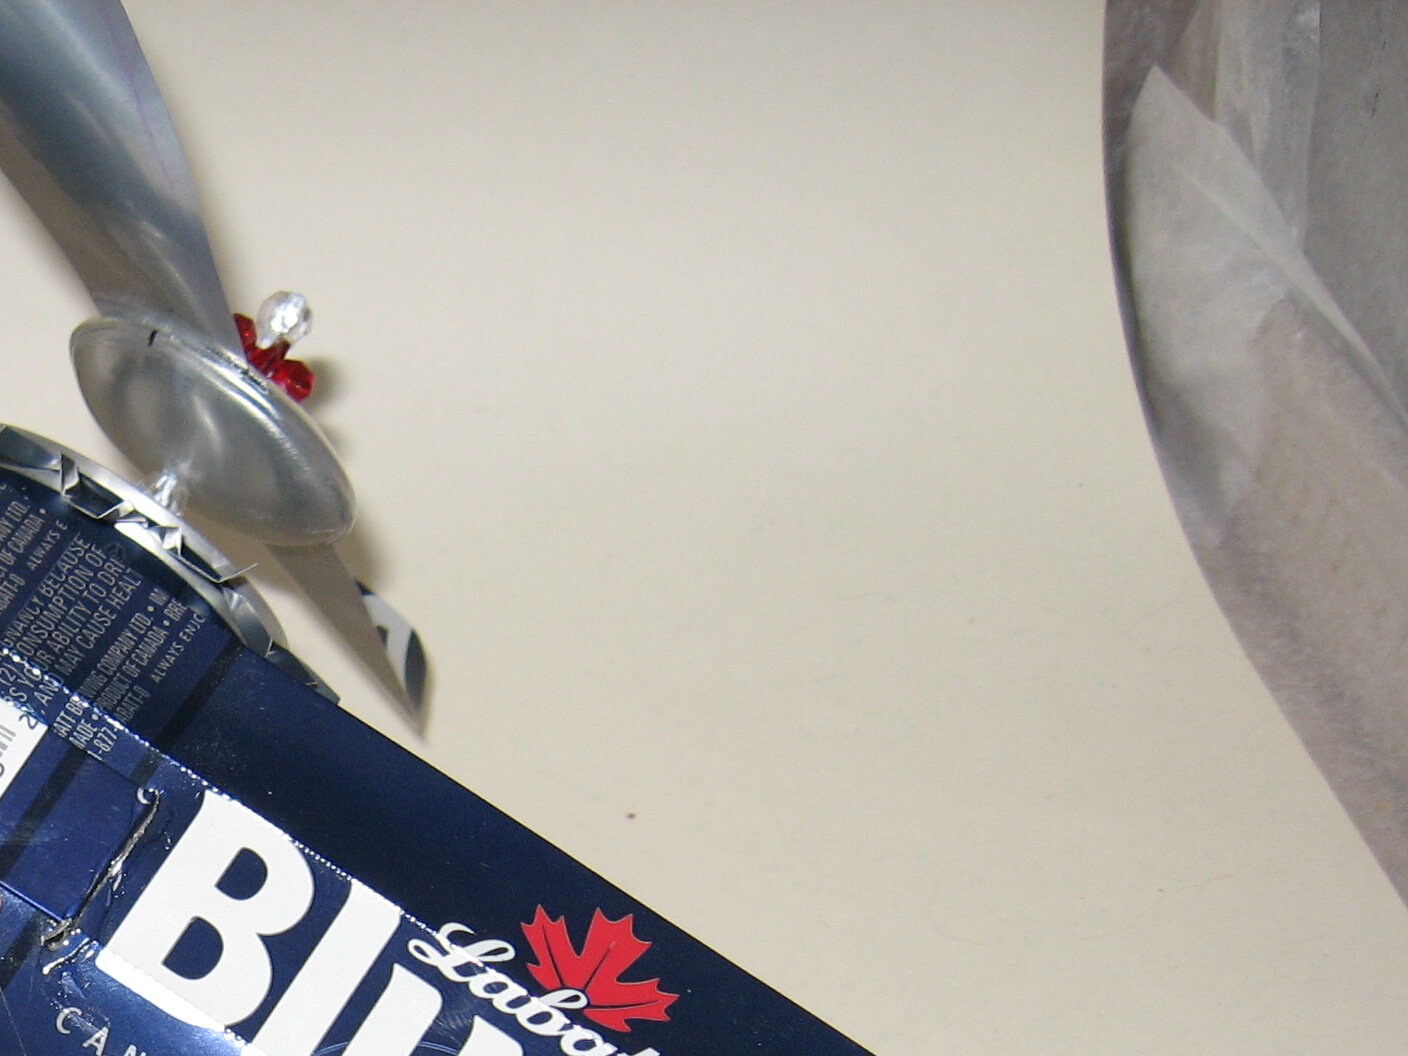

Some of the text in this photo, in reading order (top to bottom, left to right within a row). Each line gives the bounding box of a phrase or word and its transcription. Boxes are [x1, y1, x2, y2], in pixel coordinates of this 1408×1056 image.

[6, 510, 47, 555] CANADA
[23, 527, 62, 572] ALWAYS
[36, 532, 92, 599] BECAUSE
[83, 543, 109, 568] OF
[44, 599, 93, 655] ABILITY
[82, 580, 107, 605] TO
[54, 642, 86, 677] MAY
[74, 602, 117, 651] CAUSE
[65, 607, 154, 718] BRWING COMPANY LTD.
[130, 623, 169, 667] CANADA
[121, 659, 142, 679] OF
[17, 710, 40, 731] 2
[85, 683, 151, 762] 1-877-ABATT-0
[148, 640, 185, 684] ALWAYS
